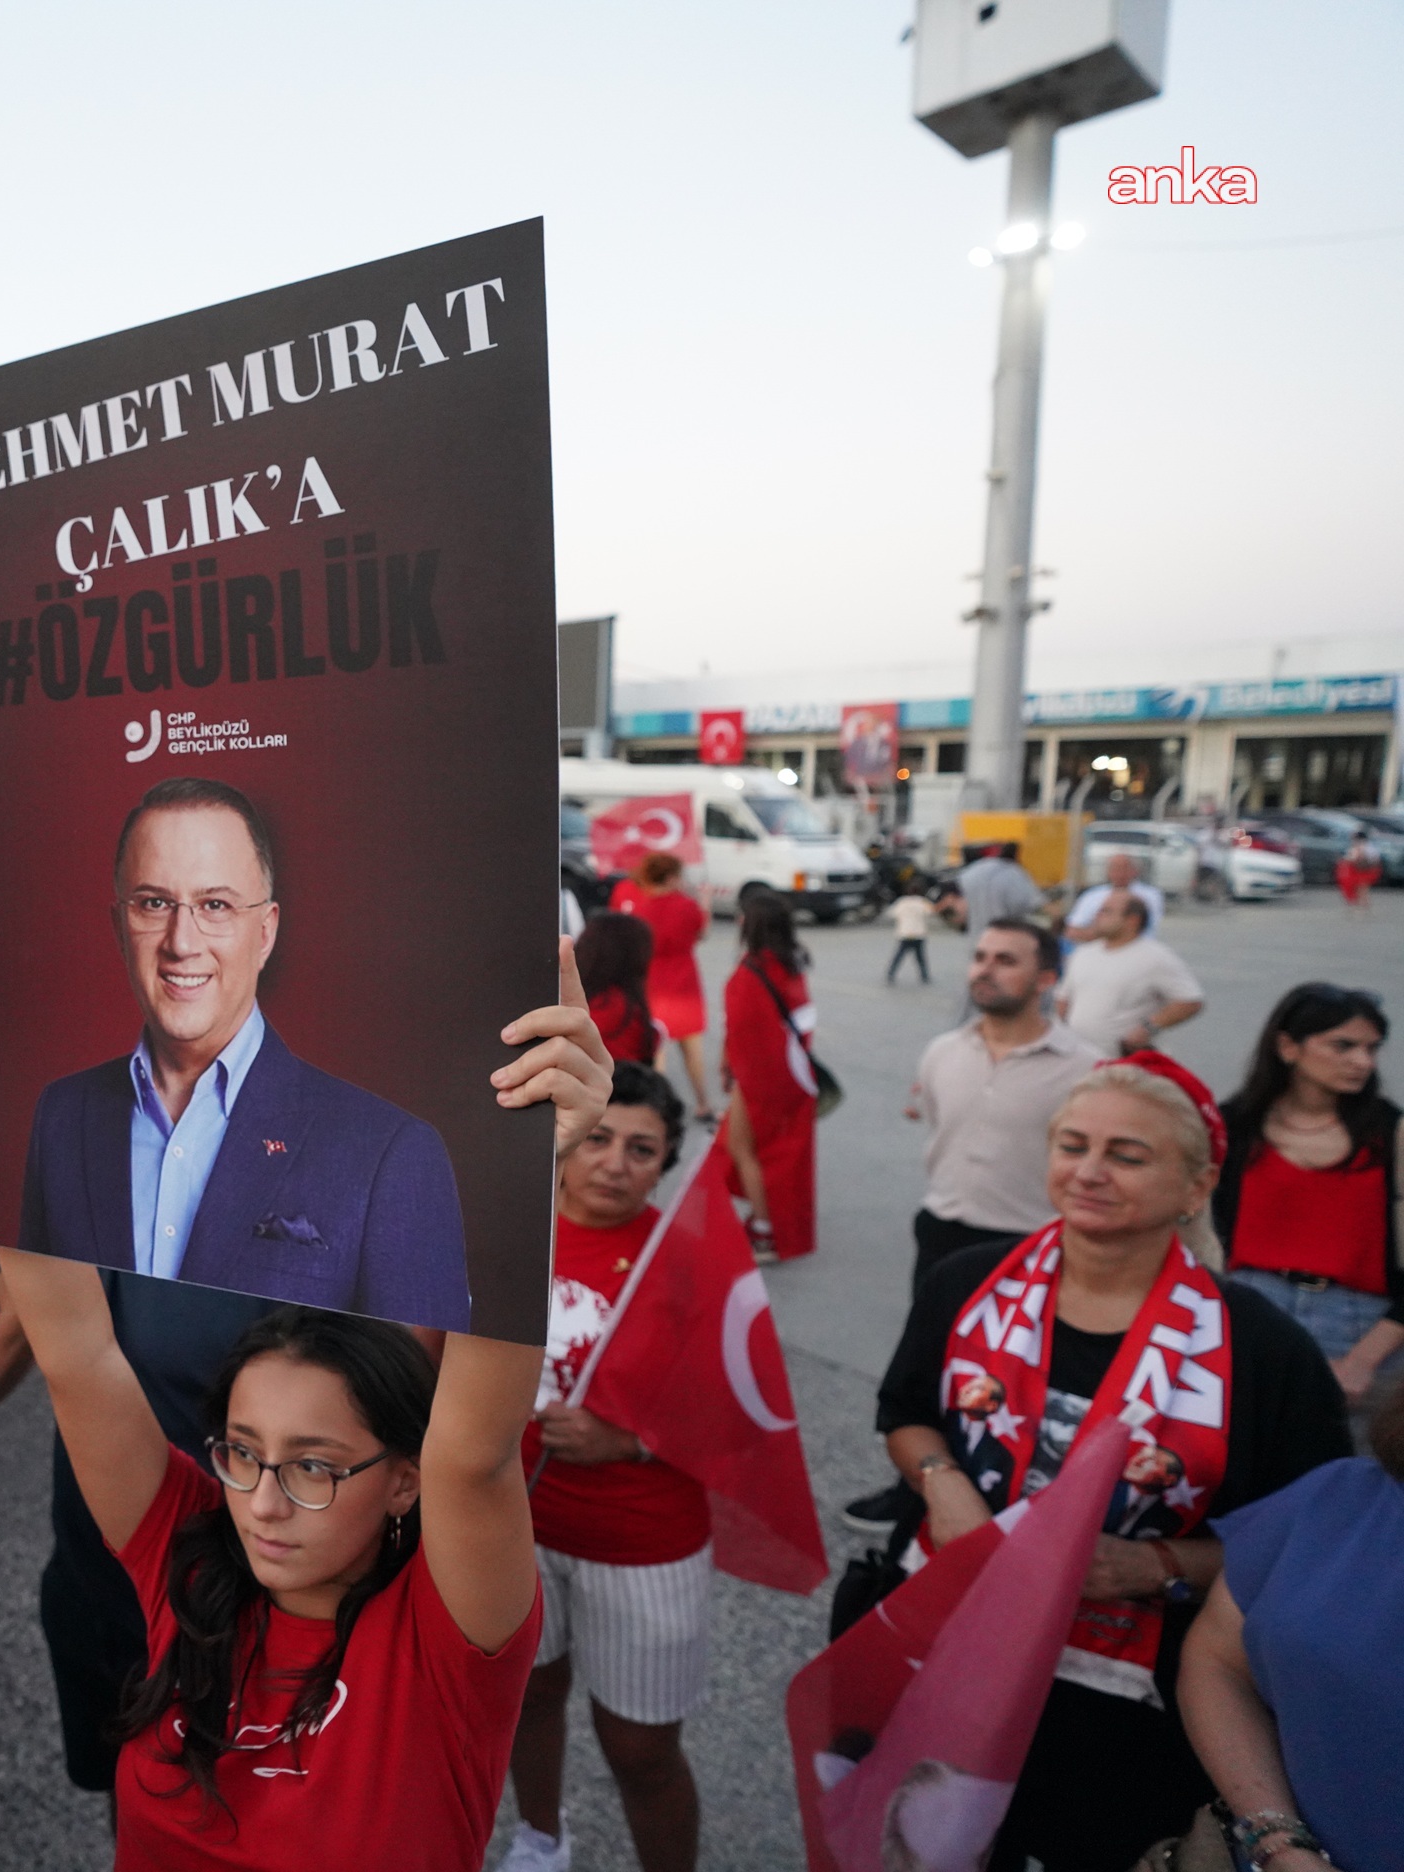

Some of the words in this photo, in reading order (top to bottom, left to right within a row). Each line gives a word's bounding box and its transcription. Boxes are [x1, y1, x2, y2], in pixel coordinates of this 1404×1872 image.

[206, 277, 505, 427] MURAT
[55, 456, 346, 593] ÇALIK’A
[167, 711, 196, 726] CHP
[167, 720, 250, 740] BEYLİKDÜZÜ
[168, 737, 226, 755] GENÇLİK
[229, 734, 288, 750] KOLLARI
